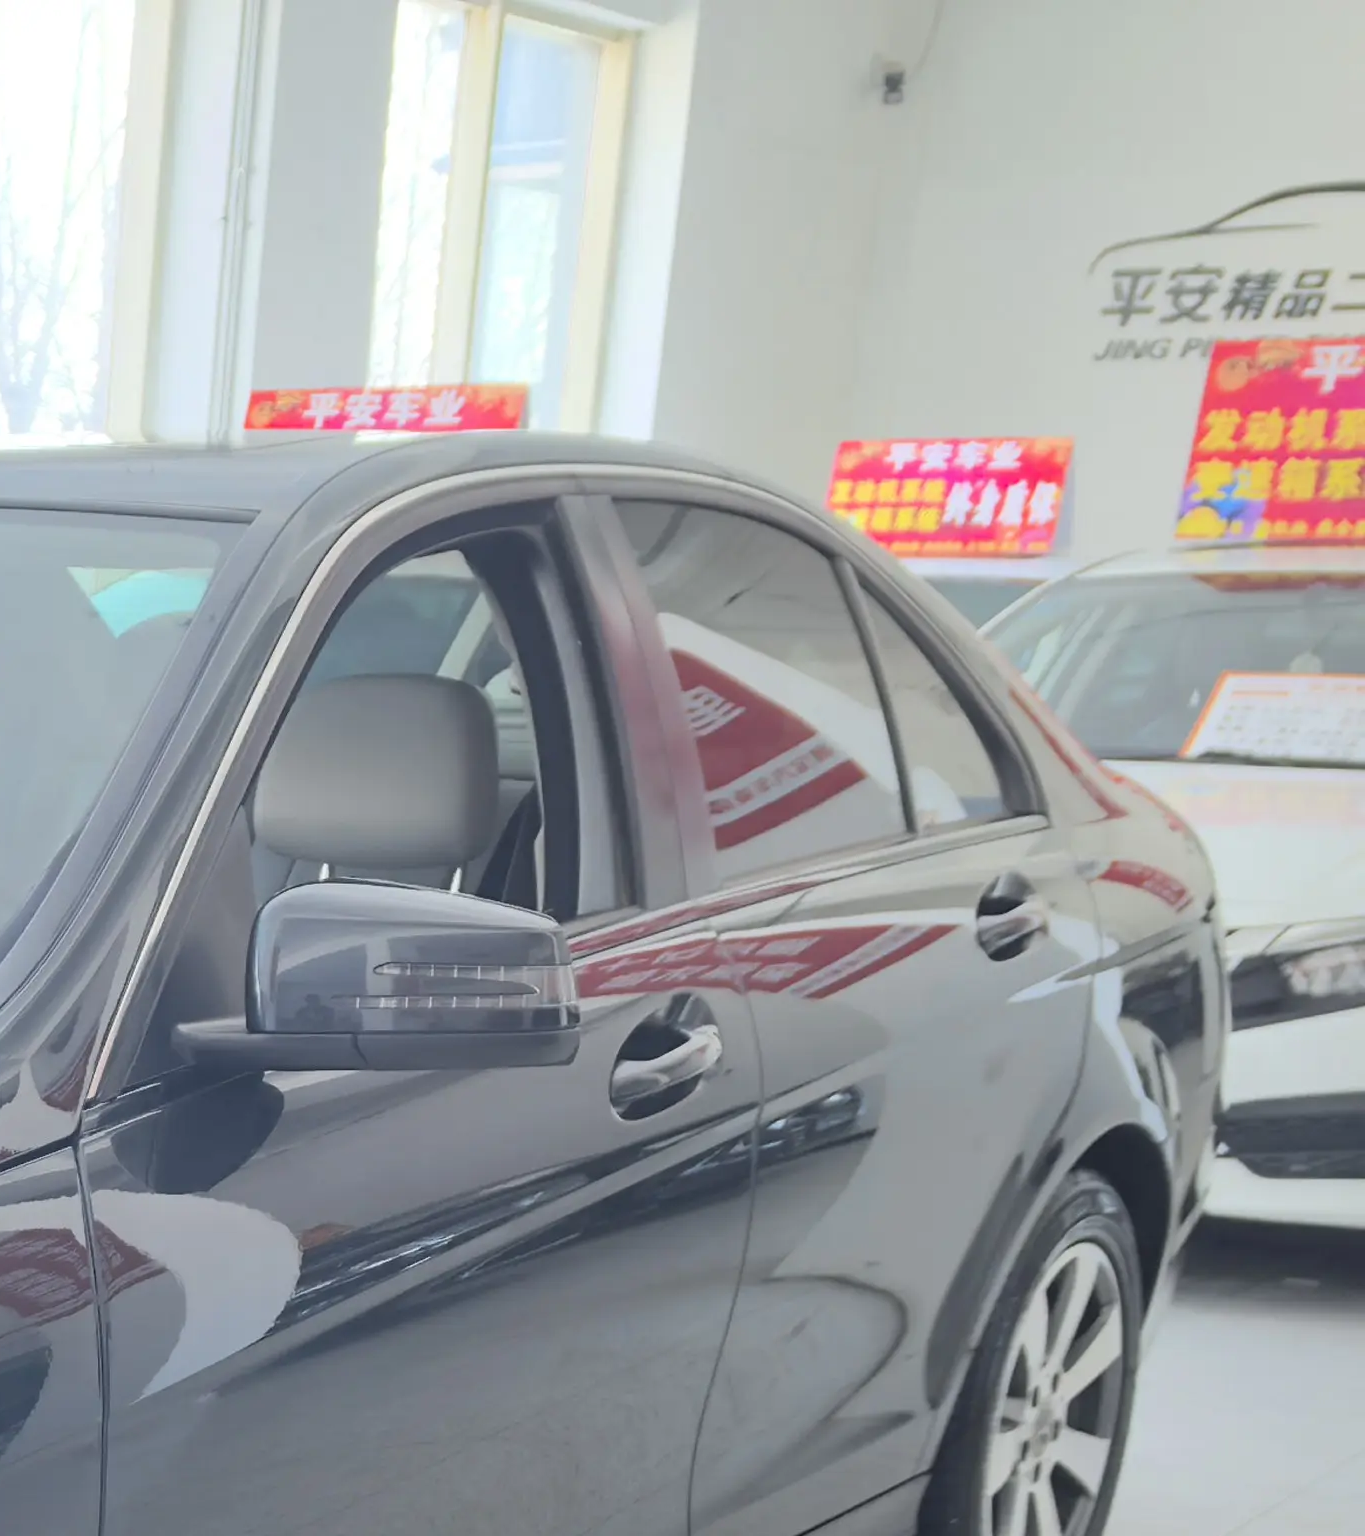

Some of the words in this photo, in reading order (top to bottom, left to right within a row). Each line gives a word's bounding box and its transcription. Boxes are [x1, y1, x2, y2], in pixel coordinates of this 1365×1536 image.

[1094, 338, 1172, 361] JING
[302, 391, 467, 429] 平安车业
